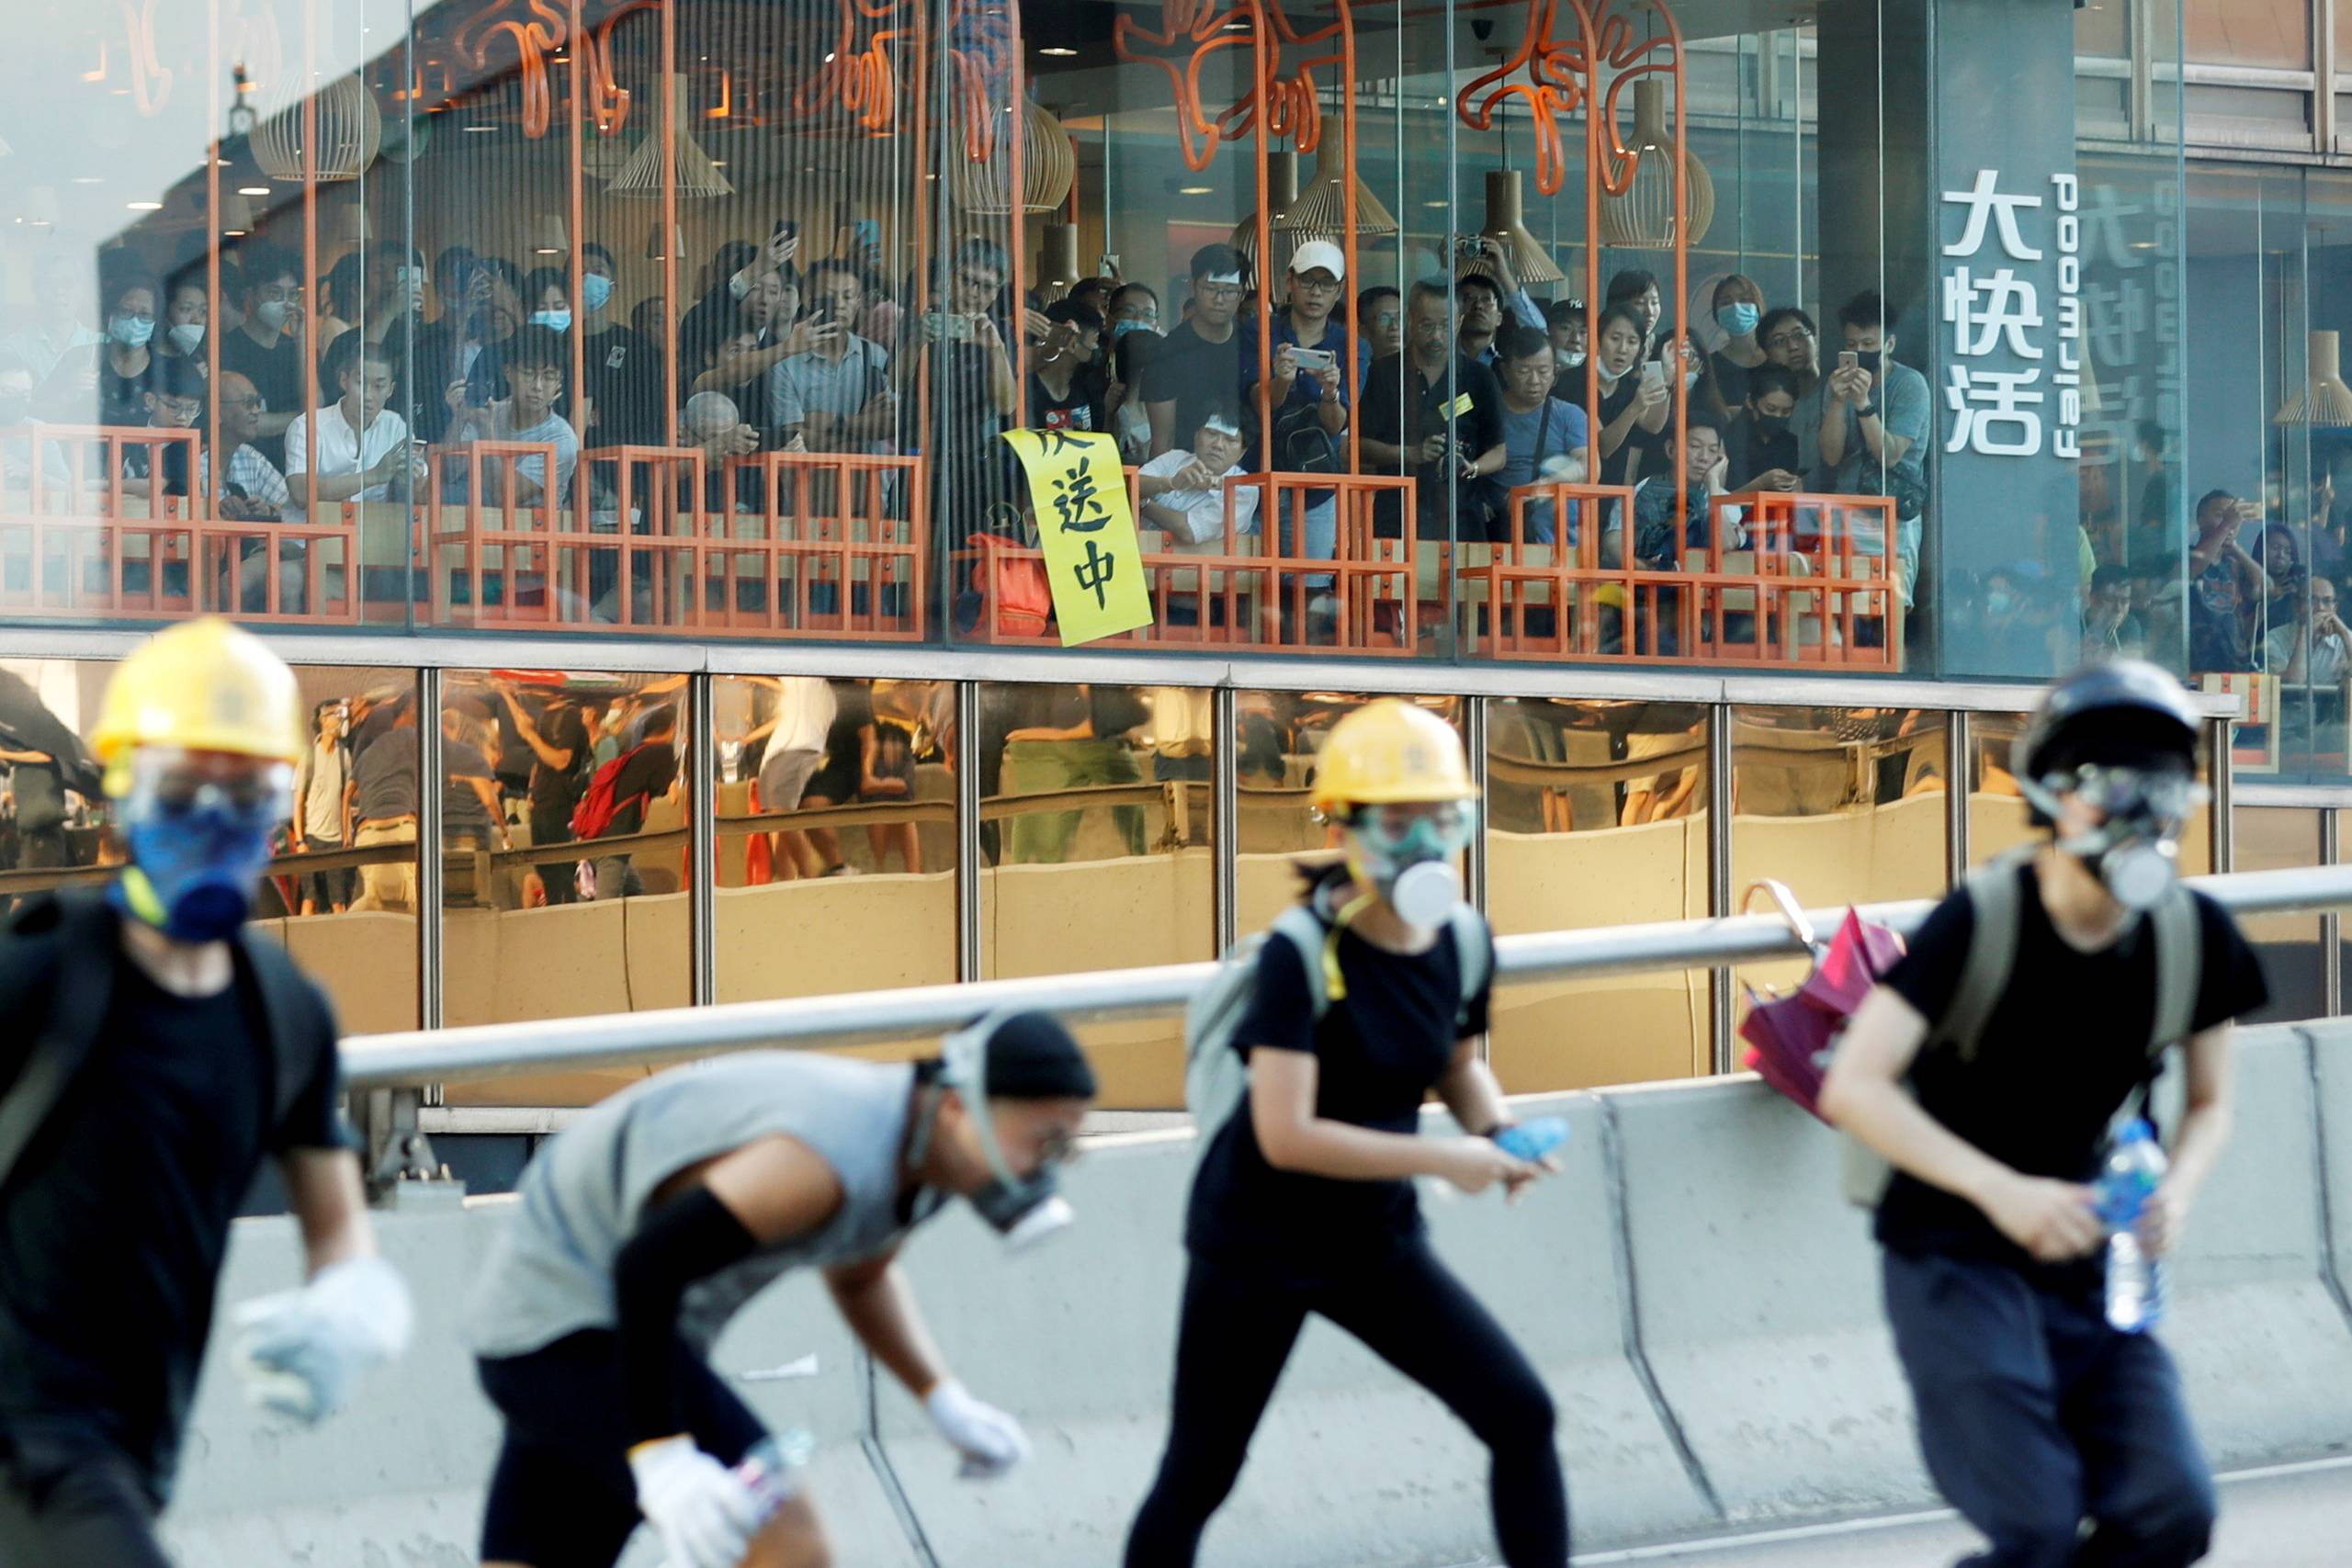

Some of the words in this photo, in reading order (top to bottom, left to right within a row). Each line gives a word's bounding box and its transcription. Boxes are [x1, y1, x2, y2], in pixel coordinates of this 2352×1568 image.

[1941, 169, 2043, 457] 大快活
[2051, 173, 2081, 458] Fairwood
